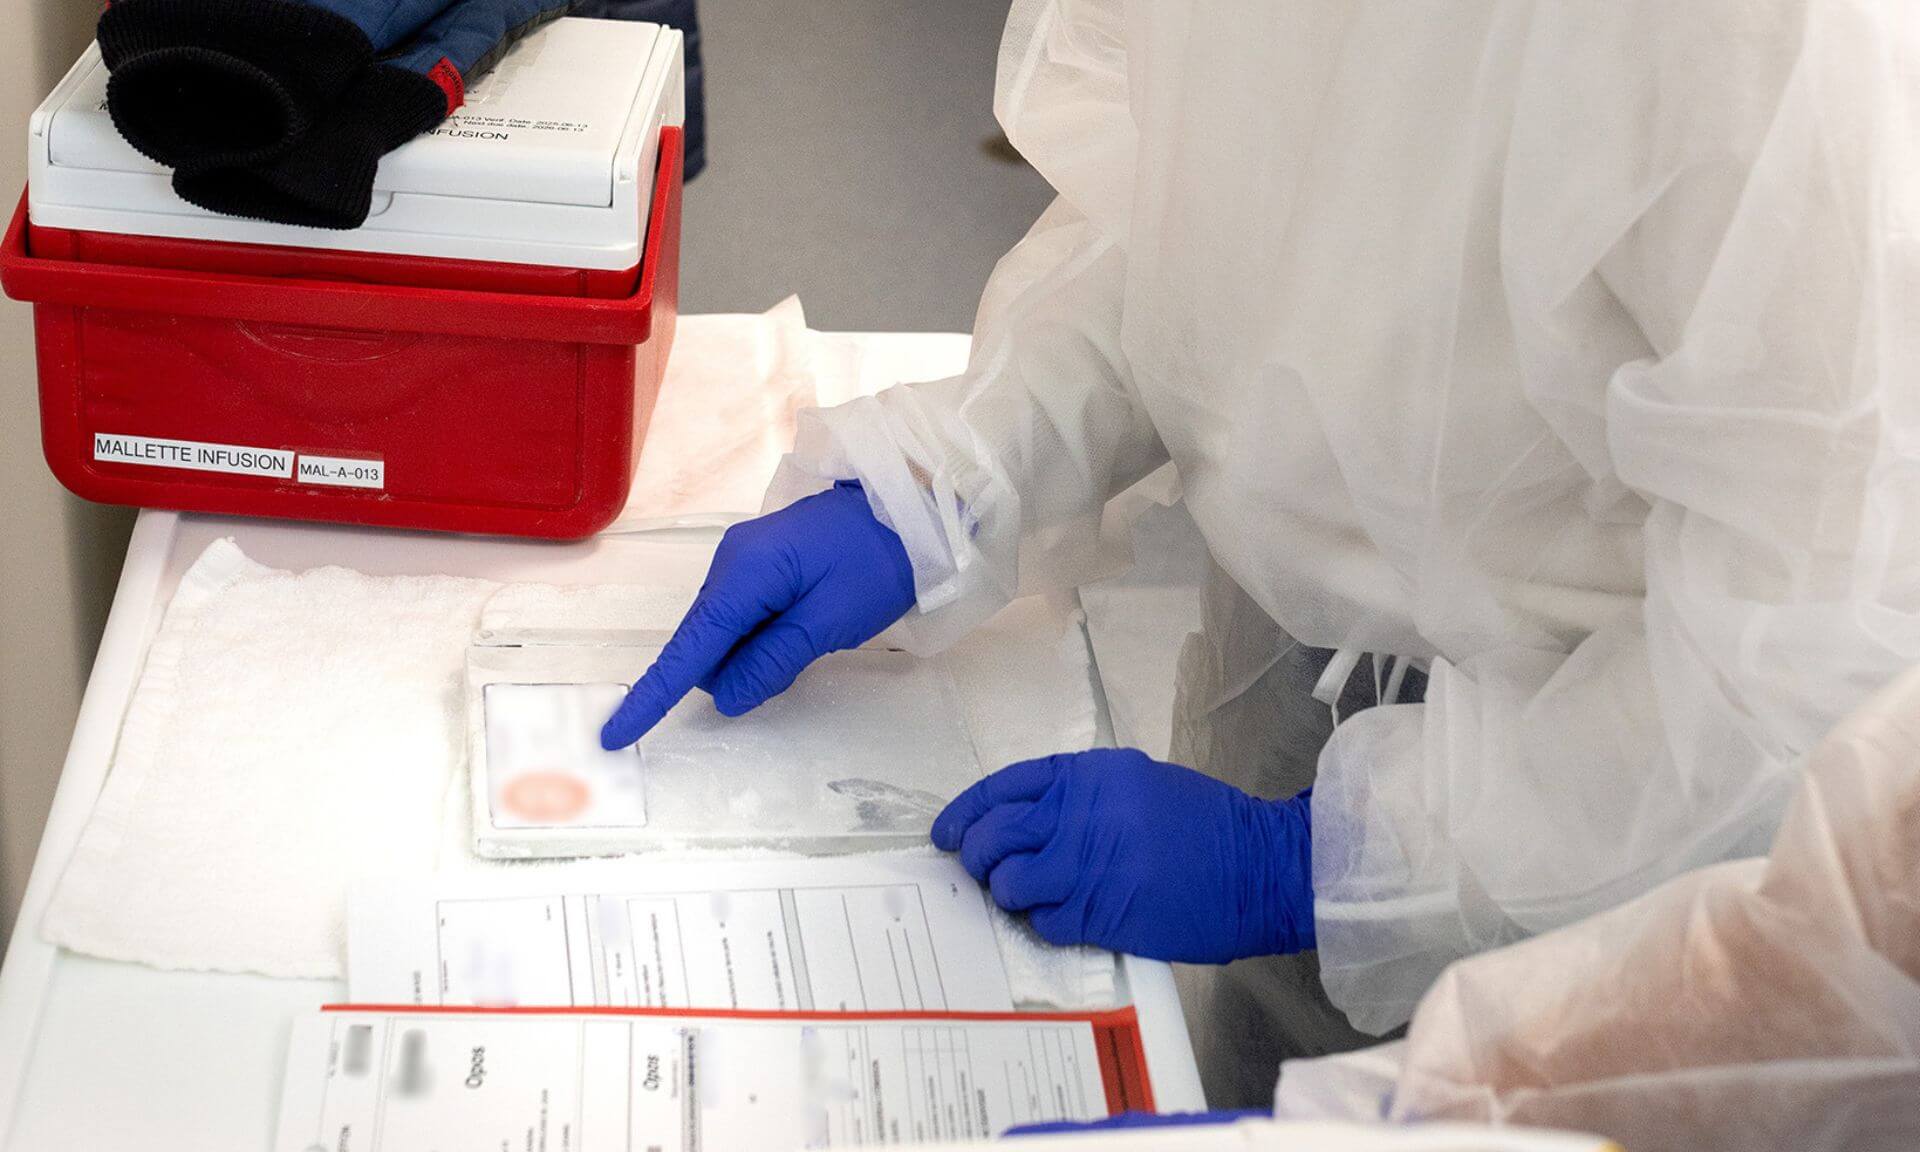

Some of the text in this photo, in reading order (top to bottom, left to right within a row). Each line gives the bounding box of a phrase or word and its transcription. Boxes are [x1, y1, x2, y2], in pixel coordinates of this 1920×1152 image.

[422, 129, 509, 140] NFUSION
[95, 438, 286, 471] MALLETTE INFUSION
[299, 463, 379, 481] MAL-A-013
